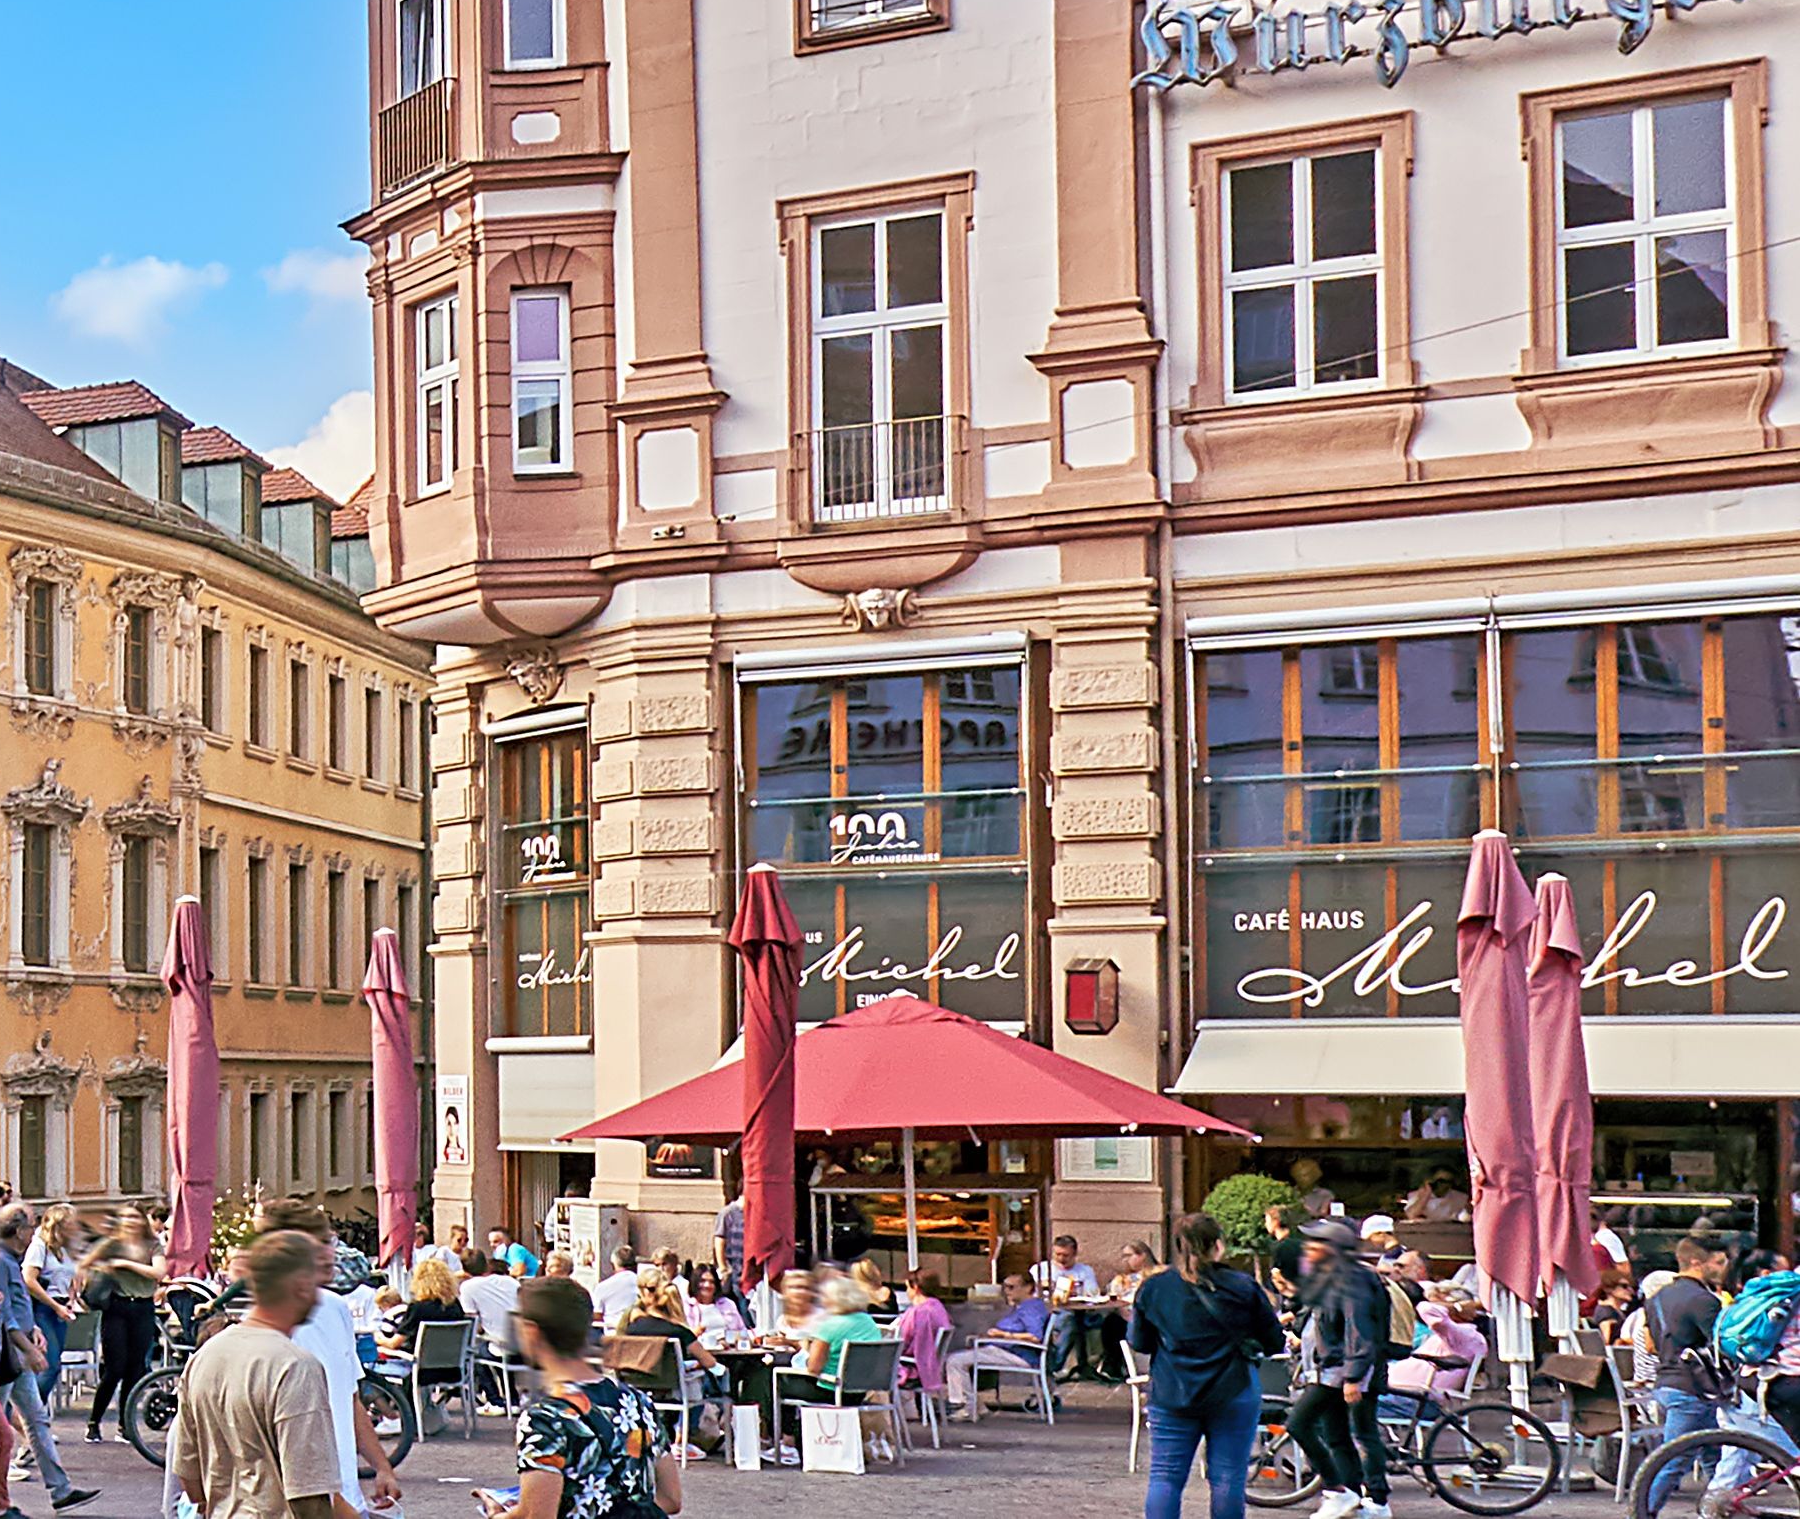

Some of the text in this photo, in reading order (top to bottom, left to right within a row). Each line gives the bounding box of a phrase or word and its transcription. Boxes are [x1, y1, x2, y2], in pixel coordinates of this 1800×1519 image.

[829, 812, 906, 840] 100
[1234, 908, 1364, 931] CAFÉ HAUS
[799, 926, 1019, 987] Michel
[1237, 890, 1789, 1006] Mhel
